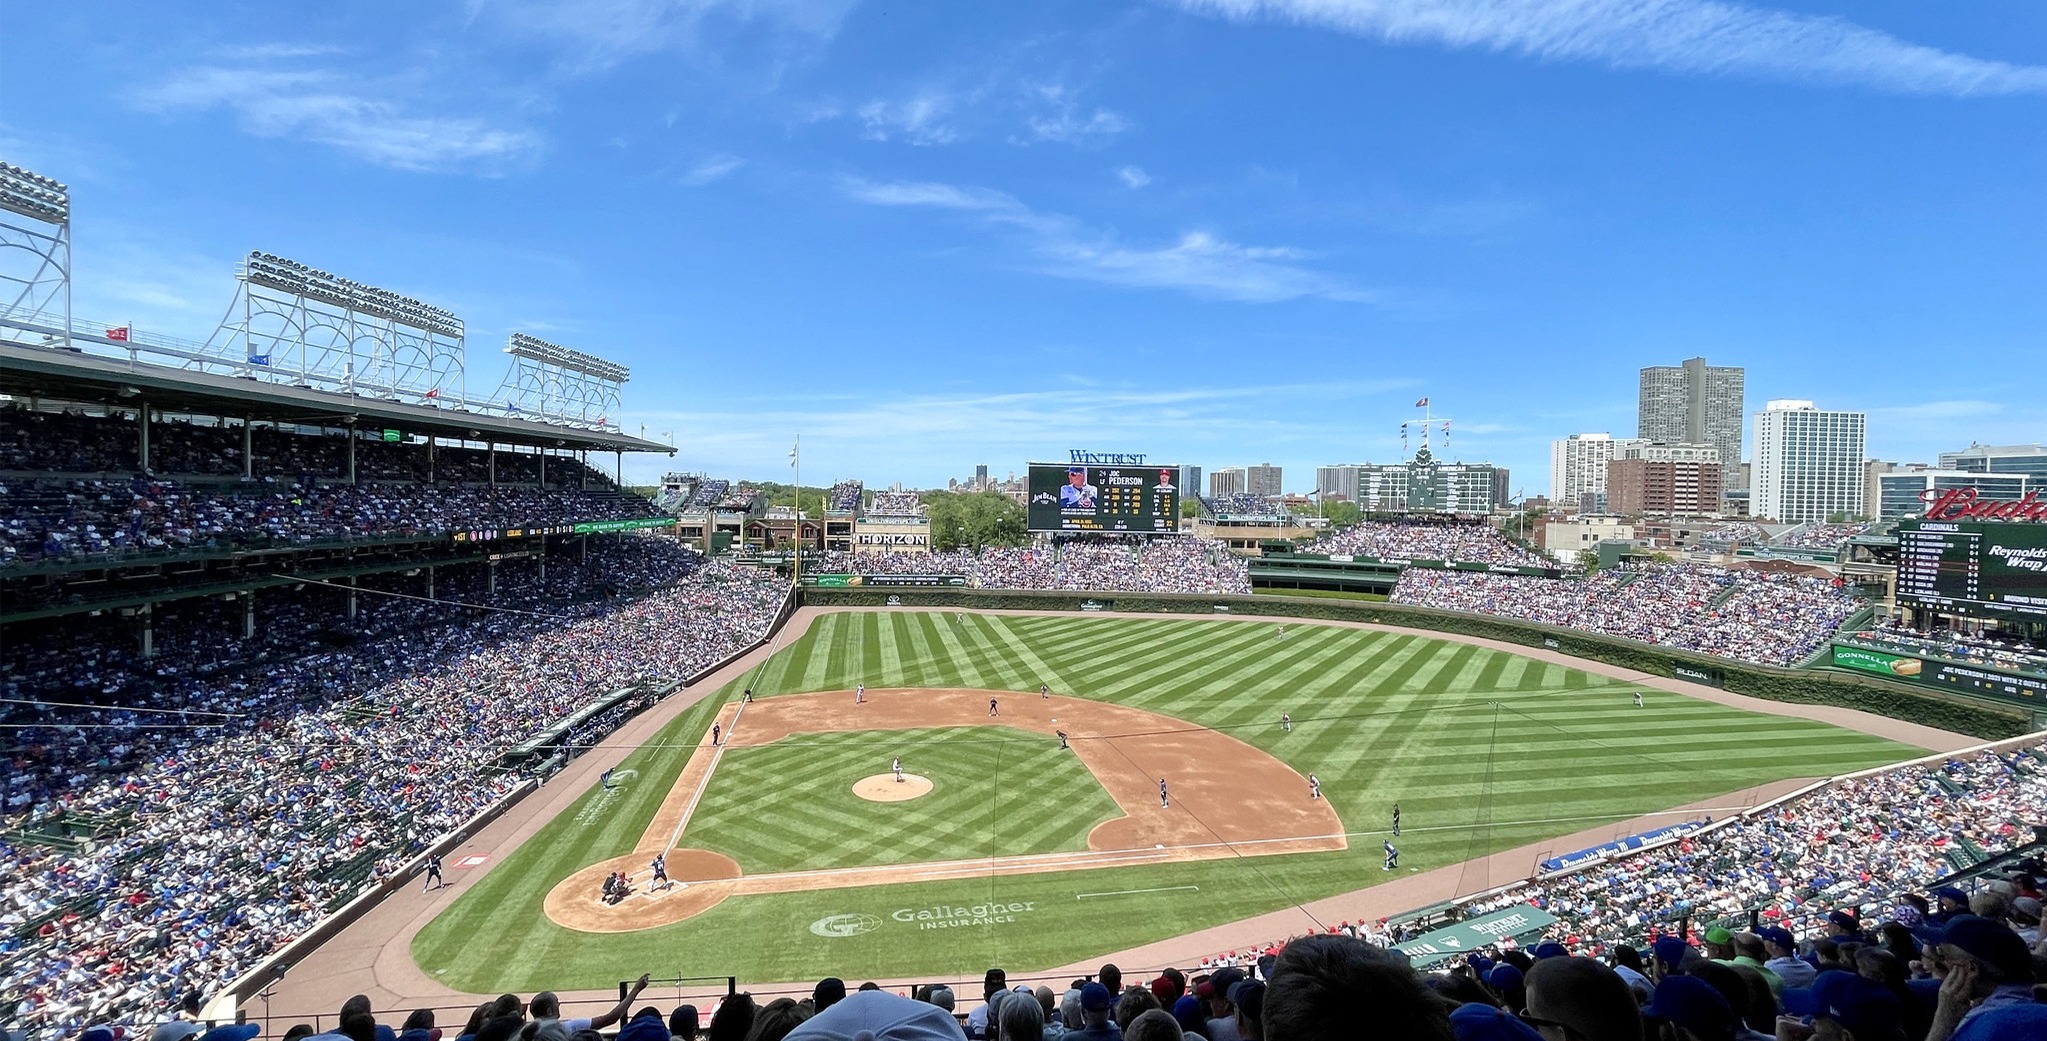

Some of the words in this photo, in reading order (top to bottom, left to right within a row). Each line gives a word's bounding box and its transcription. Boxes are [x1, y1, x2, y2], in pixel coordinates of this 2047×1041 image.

[1069, 450, 1146, 464] WINTRUST
[1109, 477, 1142, 485] PEDERSON
[1920, 523, 1959, 531] CARDINALS
[862, 534, 925, 545] HORIZON
[1988, 545, 2047, 558] Reynolds
[2007, 556, 2042, 571] Wrap
[1837, 653, 1888, 666] GONNELLA
[1676, 667, 1707, 680] SLOAN
[1954, 668, 1984, 678] PEDERSON
[892, 902, 1035, 922] Gallagher
[920, 915, 1016, 930] INSURANCE
